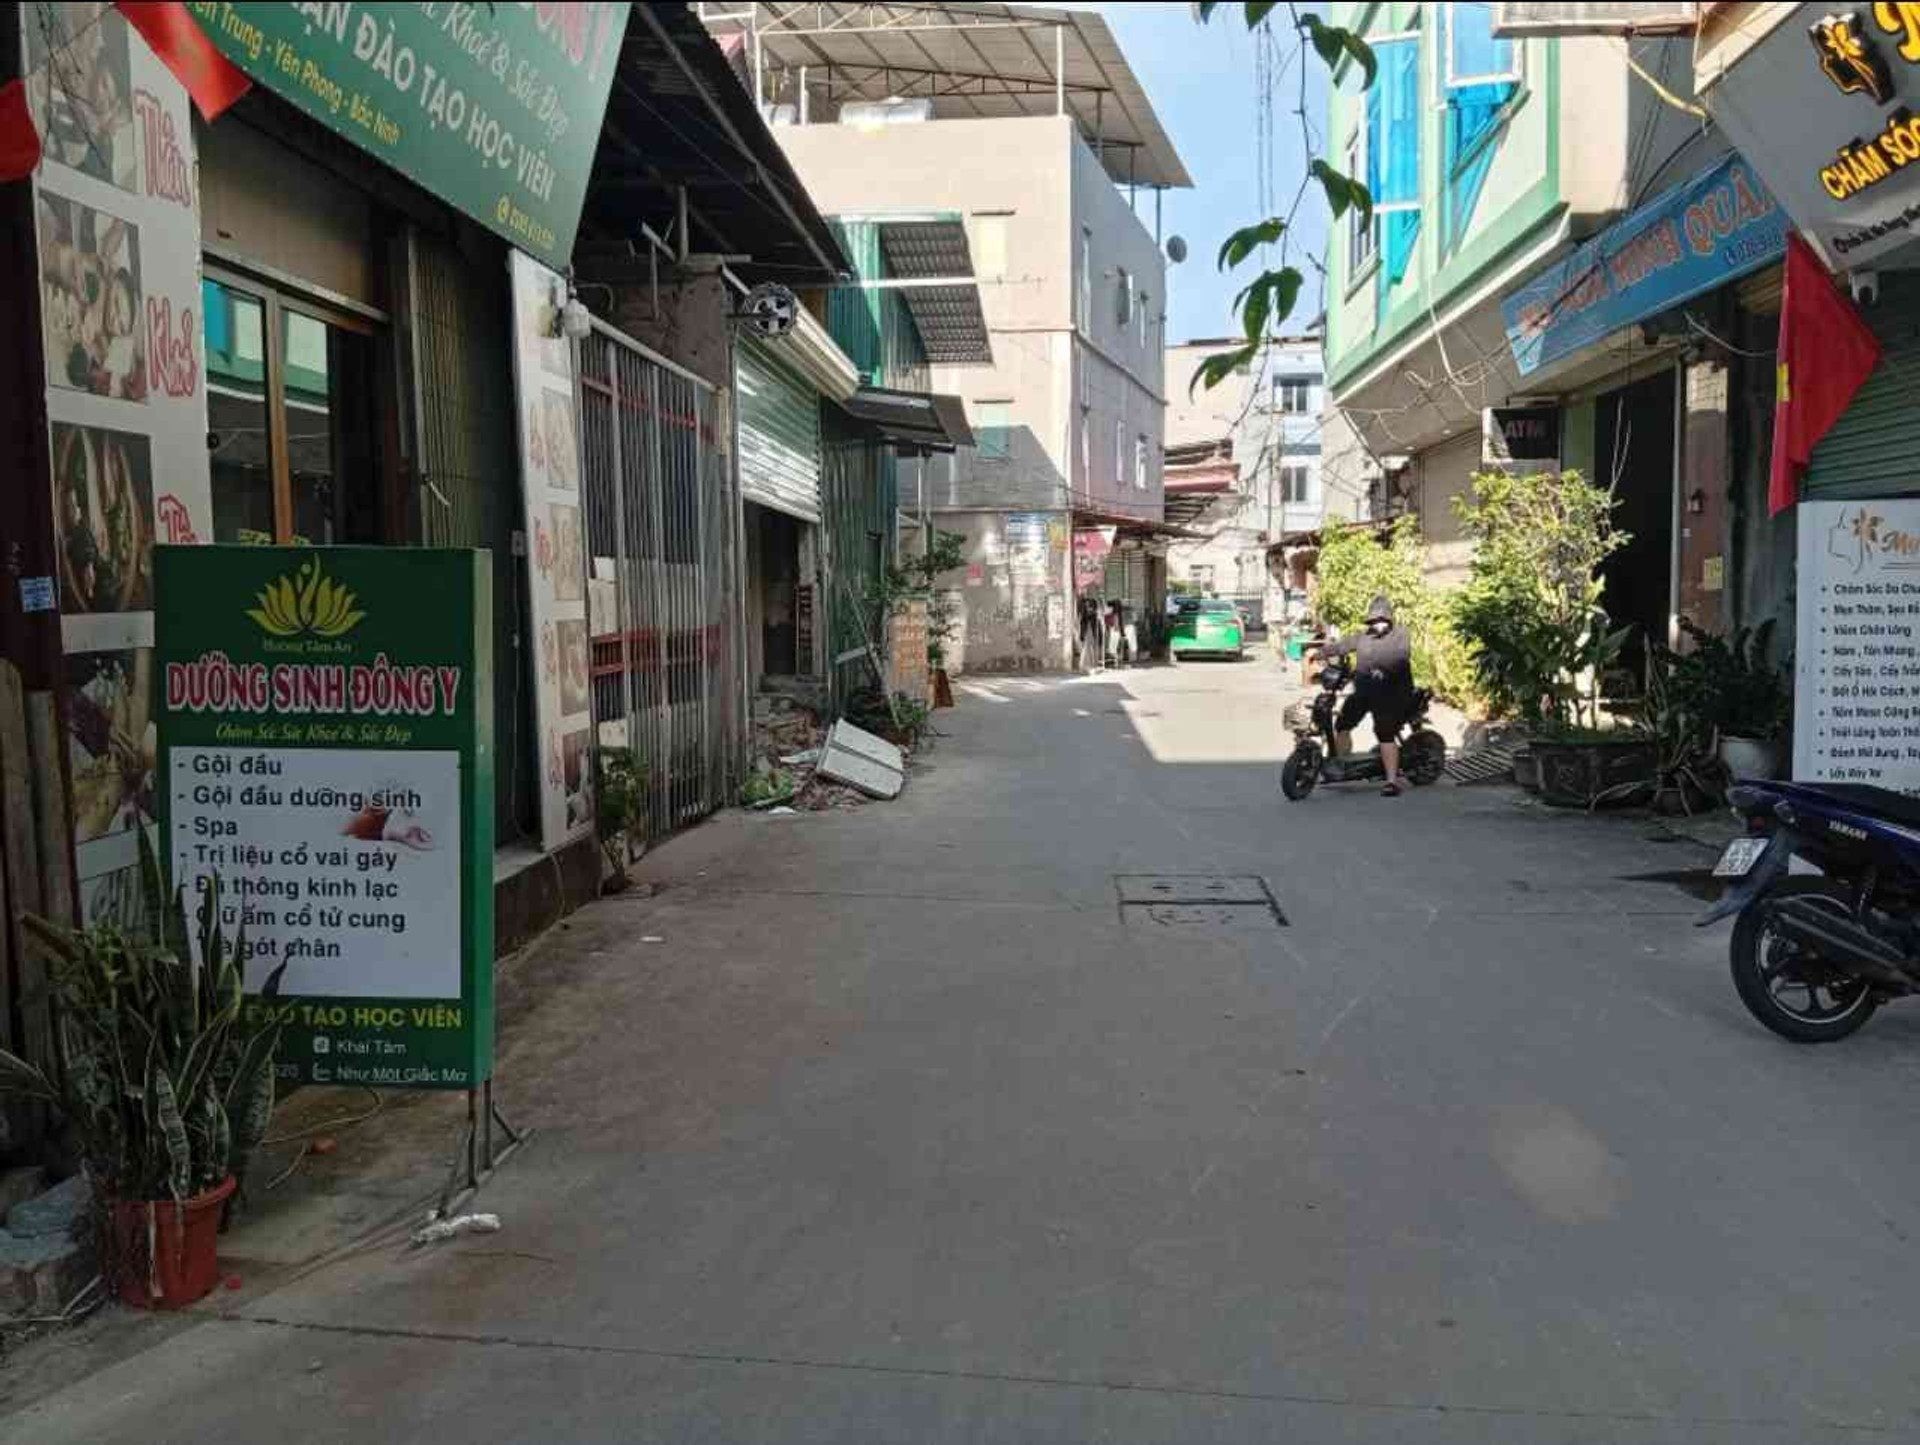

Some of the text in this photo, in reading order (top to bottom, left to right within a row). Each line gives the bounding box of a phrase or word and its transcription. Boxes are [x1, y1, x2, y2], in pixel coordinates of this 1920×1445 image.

[274, 38, 301, 84] Yên
[302, 60, 343, 114] Phong
[353, 12, 415, 91] ĐÀO
[419, 64, 466, 131] TẠO
[467, 103, 514, 169] HỌC
[516, 144, 556, 201] VIÊN
[1820, 147, 1891, 200] CHĂM
[167, 650, 460, 717] DƯỠNG SINH ĐÔNG Y
[192, 754, 232, 778] Gội
[193, 785, 233, 810] Gội
[289, 786, 363, 812] dưỡng
[371, 788, 422, 809] sinh
[193, 816, 238, 840] Spa
[194, 845, 224, 868] Trị
[231, 845, 273, 869] liệu
[280, 841, 308, 866] cổ
[315, 849, 348, 866] vai
[356, 848, 398, 872] gáy
[233, 876, 299, 900] thông
[307, 876, 356, 898] kinh
[365, 876, 397, 901] lạc
[319, 905, 342, 927] tử
[348, 914, 405, 933] cung
[302, 1004, 347, 1030] TẠO
[352, 1006, 405, 1032] HỌC
[411, 1003, 462, 1029] VIÊN
